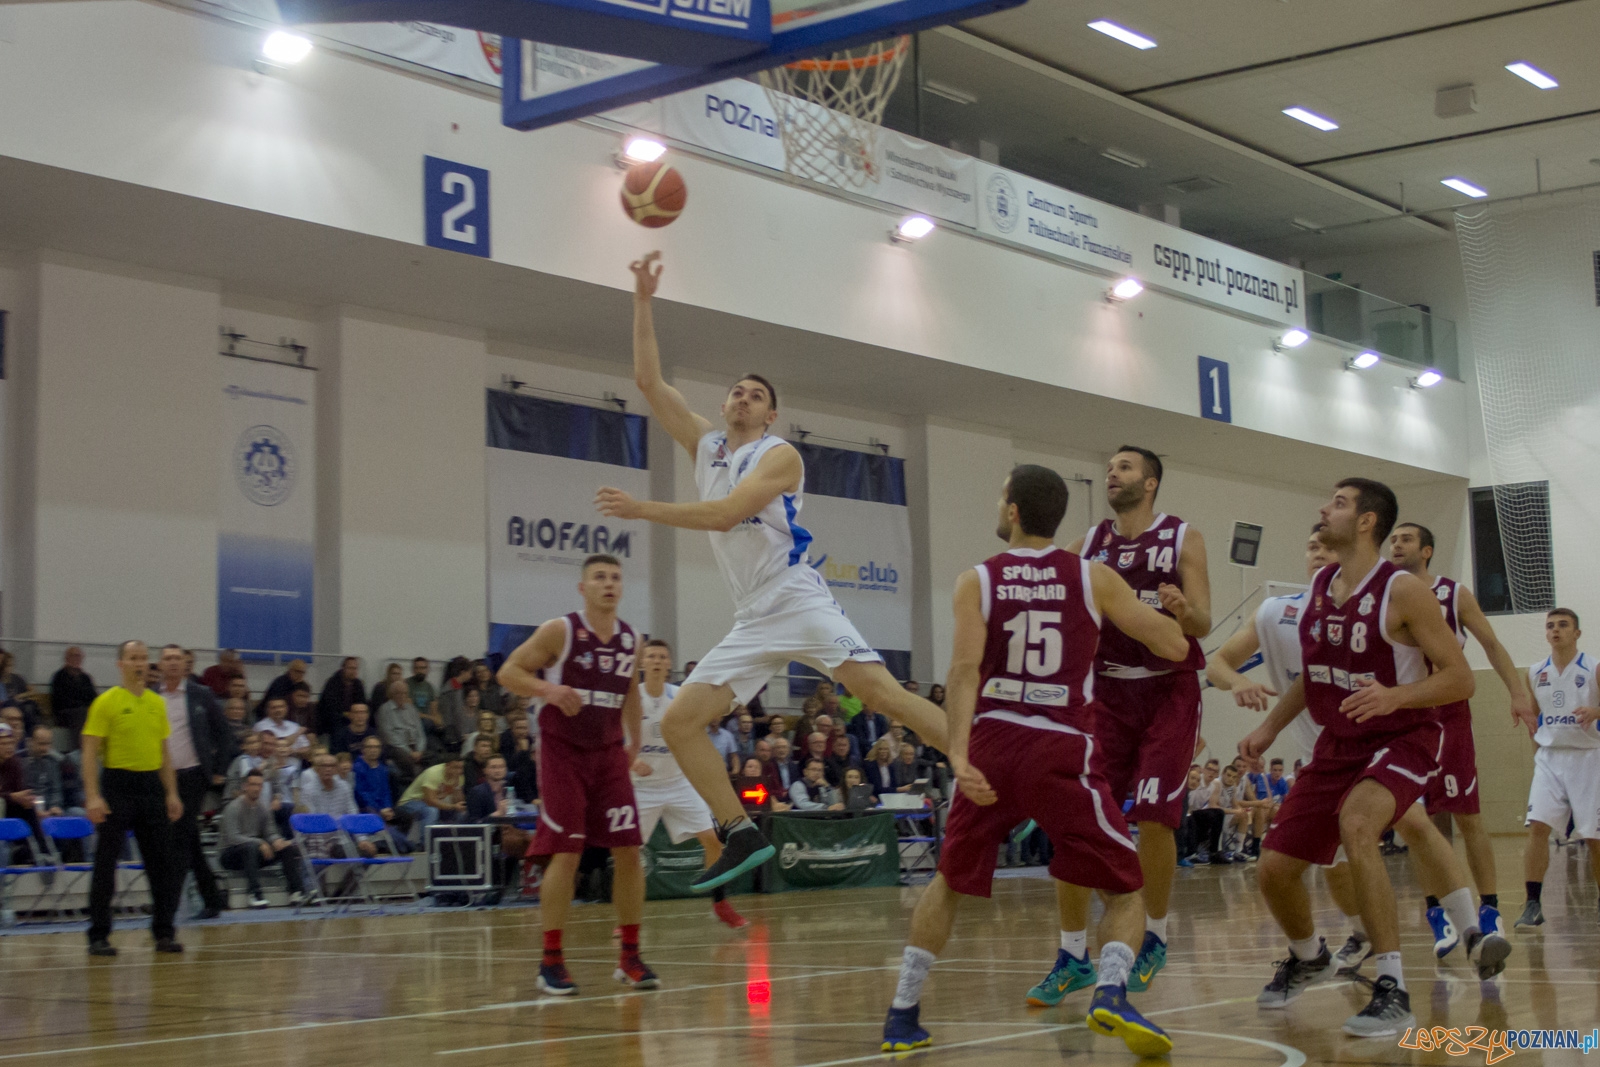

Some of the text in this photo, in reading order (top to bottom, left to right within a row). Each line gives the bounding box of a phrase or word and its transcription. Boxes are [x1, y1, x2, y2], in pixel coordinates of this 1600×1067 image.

[442, 171, 477, 245] 2
[1027, 190, 1099, 228] Centrum Sportu
[1154, 243, 1299, 314] cspp.put.poznan.pl
[1208, 366, 1223, 415] 1
[507, 515, 631, 558] BIOFARM
[1145, 545, 1174, 573] 14
[1003, 609, 1063, 677] 15
[1350, 621, 1368, 654] 8
[1552, 690, 1566, 709] 3
[1444, 774, 1459, 798] 9
[606, 805, 637, 833] 22
